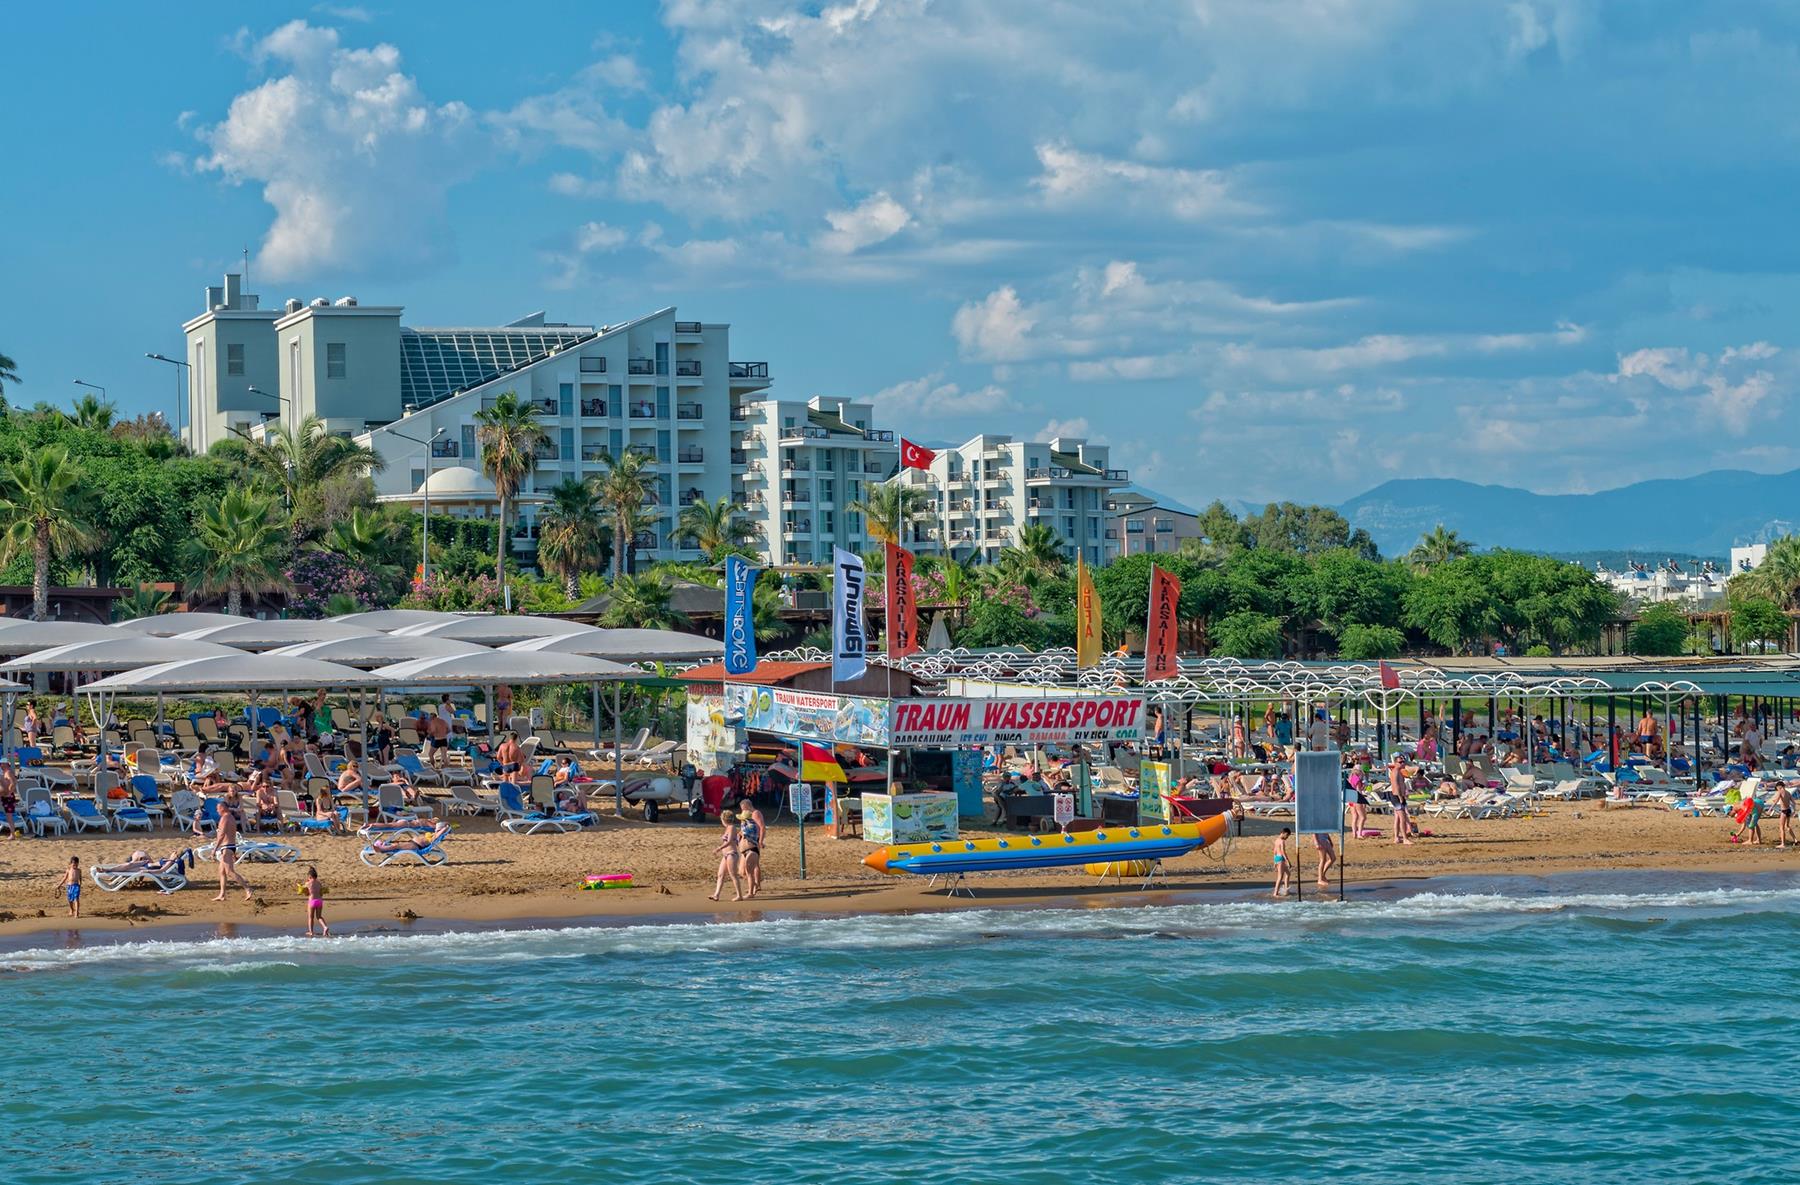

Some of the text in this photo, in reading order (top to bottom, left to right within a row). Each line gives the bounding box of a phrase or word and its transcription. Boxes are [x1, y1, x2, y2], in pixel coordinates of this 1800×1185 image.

[895, 551, 908, 649] PARASAILING
[1155, 577, 1171, 671] PARASAILING
[775, 692, 795, 704] TRAUM
[895, 700, 1142, 732] TRAUM WASSERSPORT
